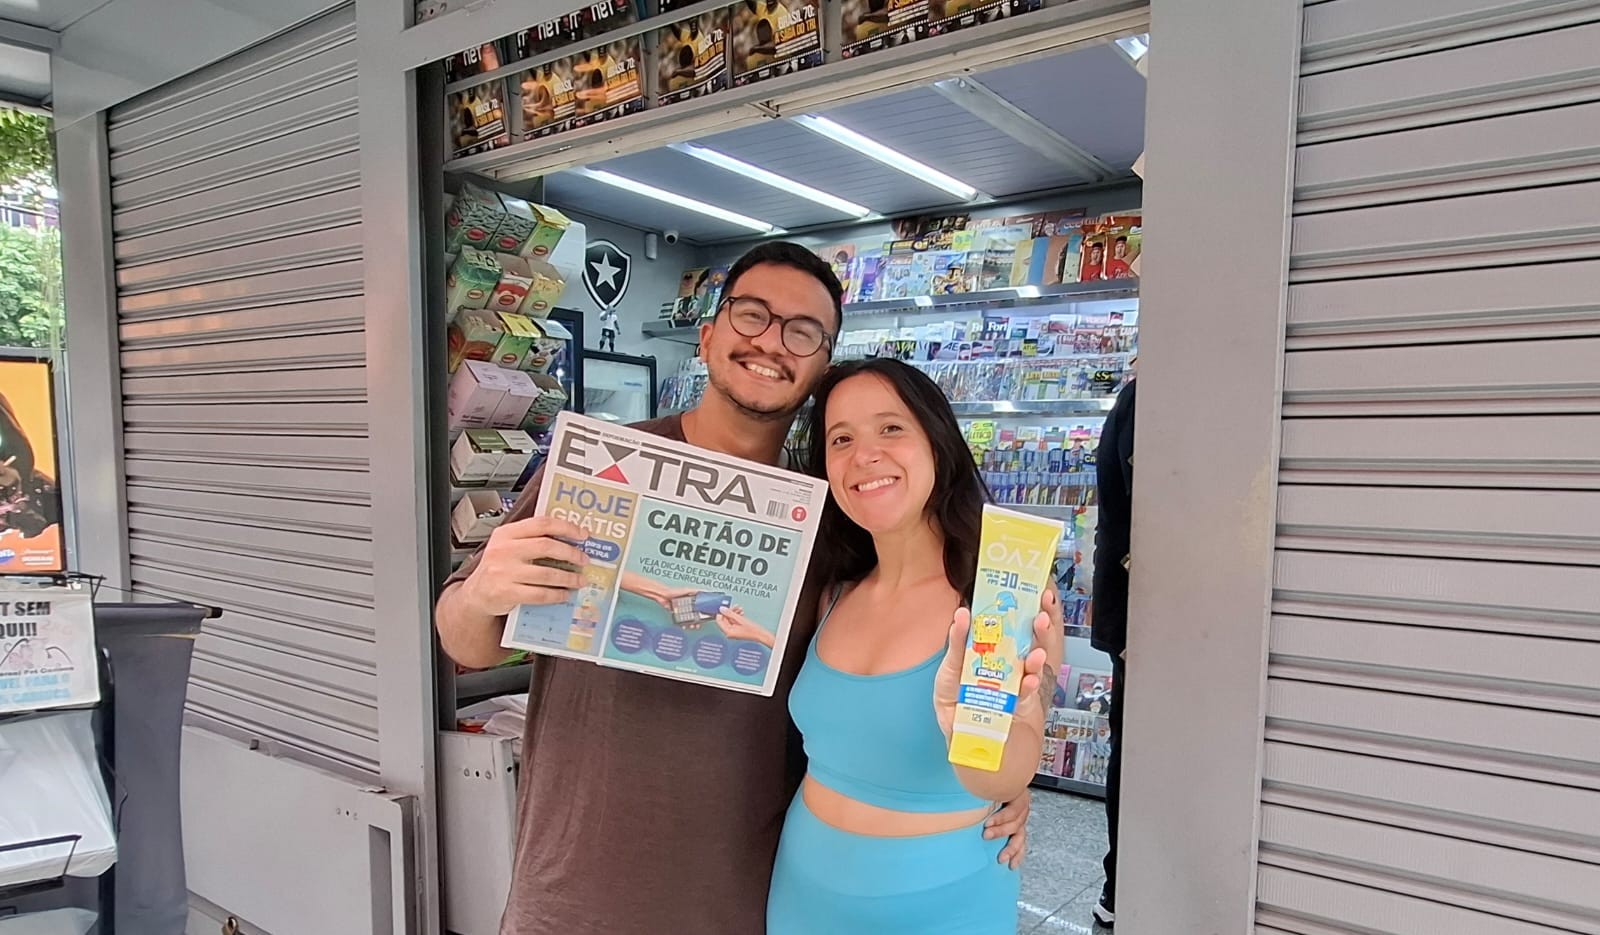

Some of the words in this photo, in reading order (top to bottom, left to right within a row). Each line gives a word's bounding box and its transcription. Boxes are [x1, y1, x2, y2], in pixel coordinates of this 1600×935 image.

[557, 430, 757, 515] EXTRA
[555, 481, 633, 519] HOJE
[550, 507, 627, 539] GRÁTIS
[646, 510, 752, 549] CARTÃO
[758, 532, 792, 557] DE
[658, 536, 769, 577] CRÉDITO
[639, 557, 660, 567] VEJA
[660, 560, 685, 572] DICAS
[686, 566, 697, 575] DE
[698, 568, 757, 588] ESPECIALISTAS
[757, 581, 778, 593] PARA
[641, 566, 661, 576] NÃO
[662, 570, 672, 578] SE
[672, 570, 713, 586] ENROLAR
[712, 580, 733, 591] COM
[739, 585, 771, 599] FATURA
[1000, 570, 1019, 590] 30
[14, 601, 51, 616] SEM
[971, 713, 982, 722] 125
